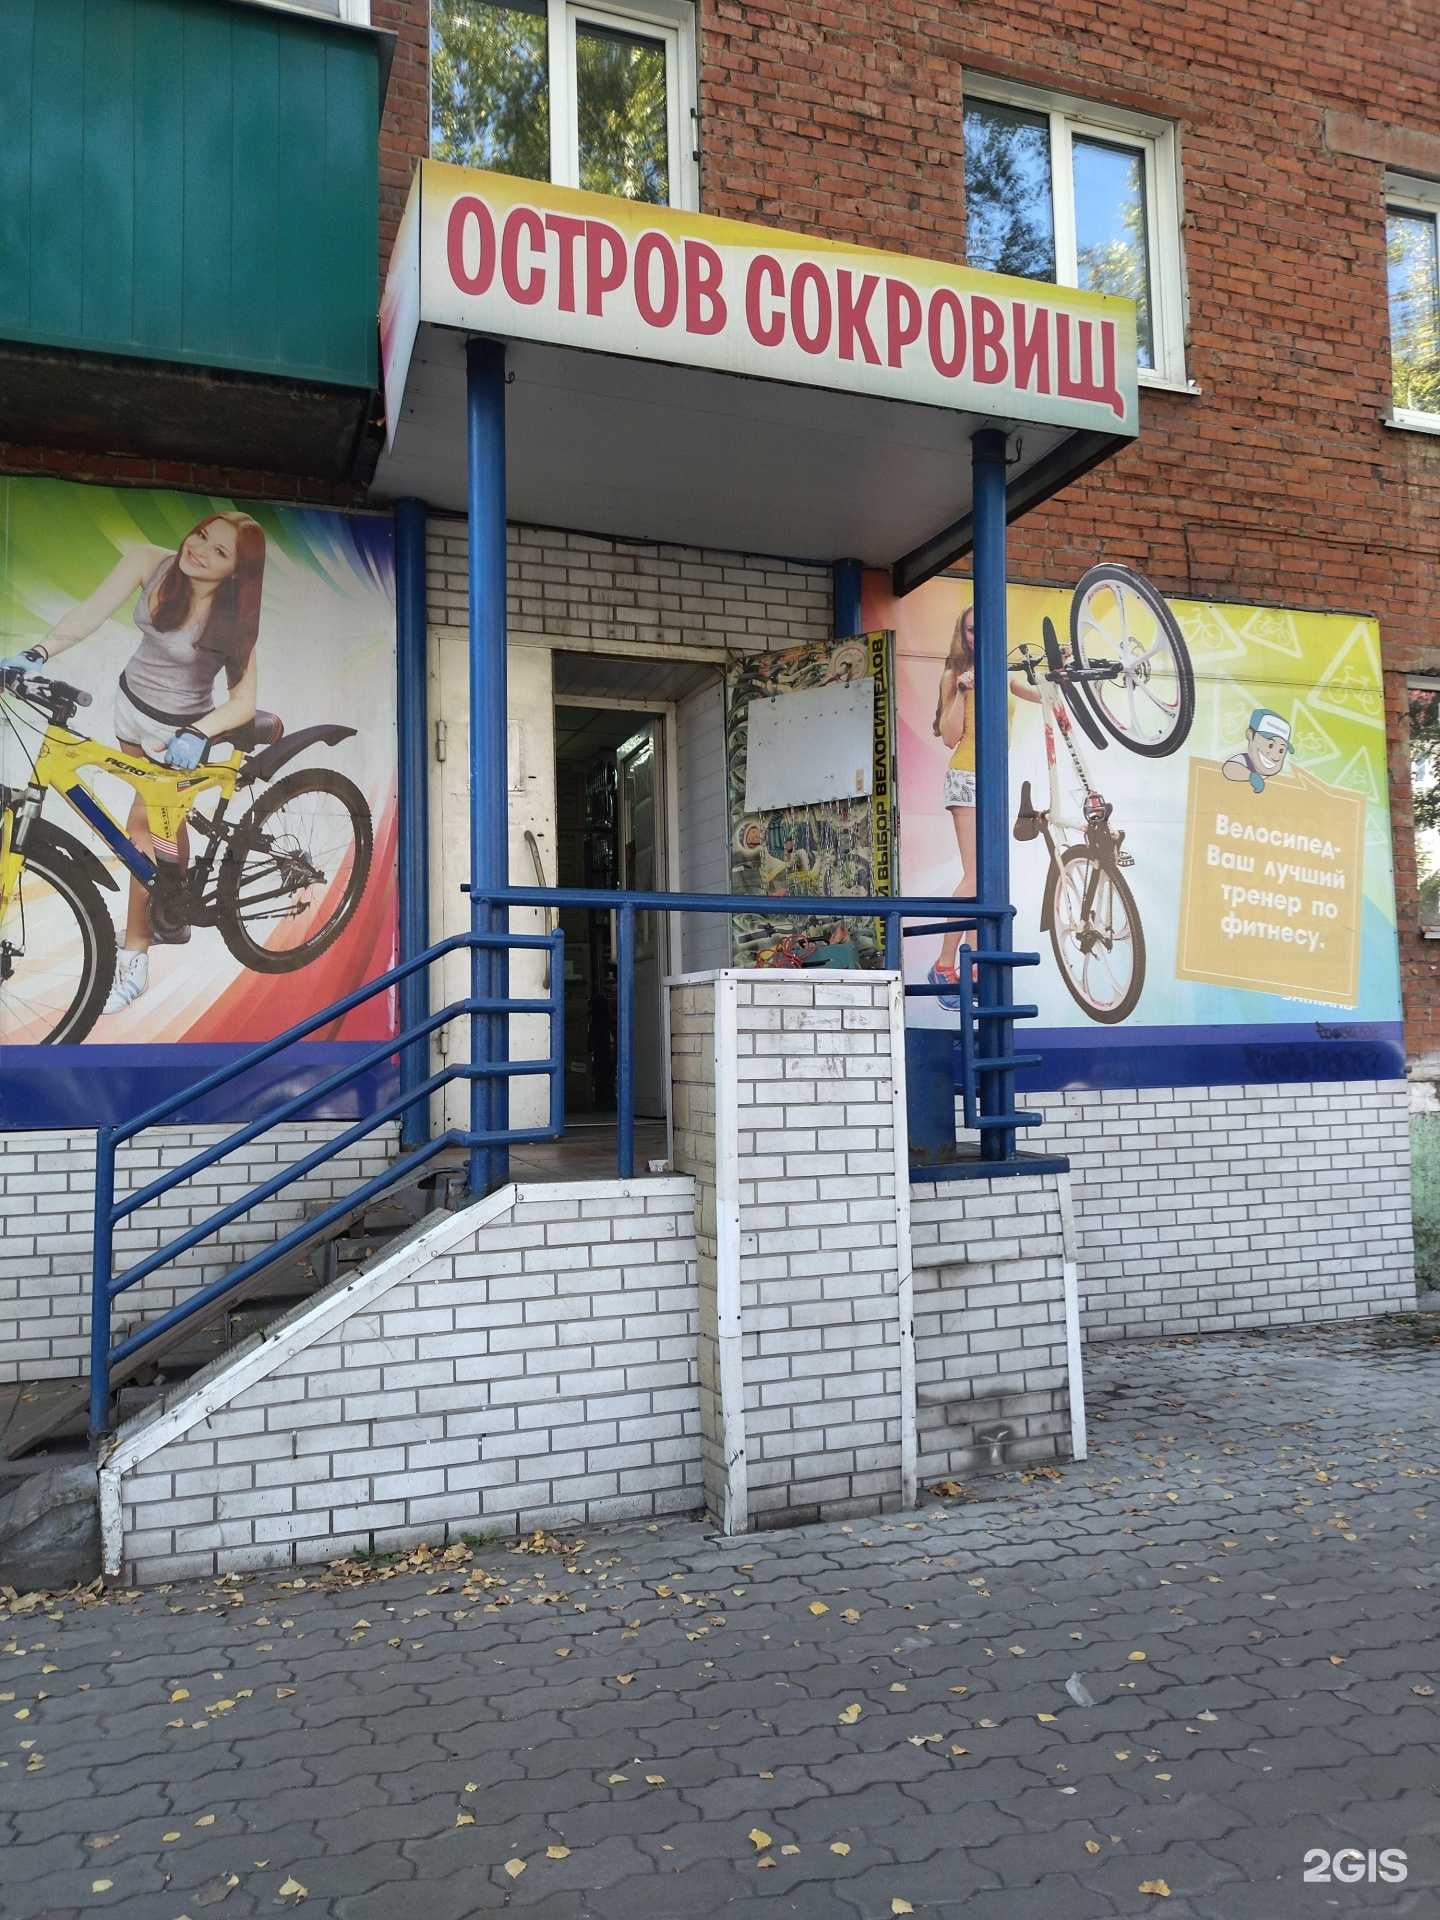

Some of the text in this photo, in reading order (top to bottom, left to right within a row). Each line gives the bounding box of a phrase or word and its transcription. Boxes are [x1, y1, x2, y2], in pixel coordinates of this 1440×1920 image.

[447, 197, 1125, 419] ОСТРОВ СОКРОВИЩ
[872, 638, 889, 796] ВЕЛОСИПЕДОВ
[875, 803, 889, 881] ВЫБОР
[1207, 844, 1345, 889] Ваш лучший
[1220, 911, 1325, 952] фитнесу.
[1221, 884, 1338, 919] тренер по
